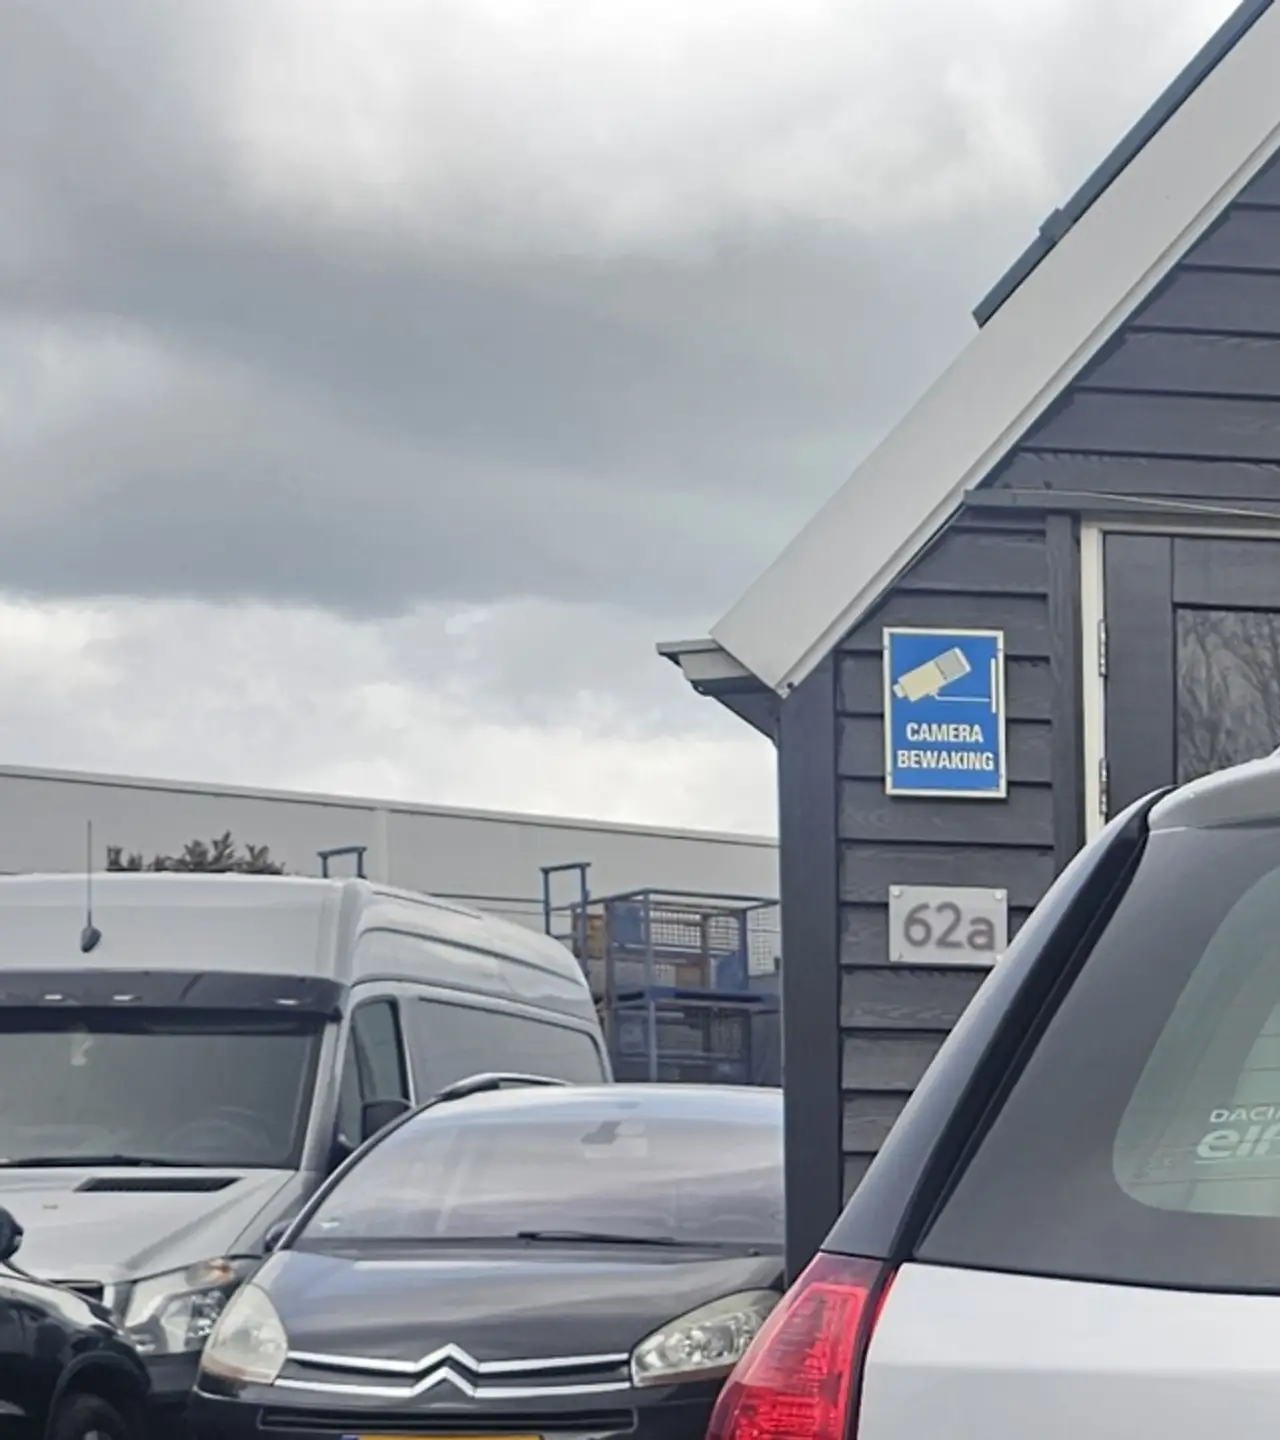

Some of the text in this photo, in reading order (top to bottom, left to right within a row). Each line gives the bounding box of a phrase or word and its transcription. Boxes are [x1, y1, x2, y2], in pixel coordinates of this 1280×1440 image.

[906, 722, 984, 744] CAMERA
[897, 750, 994, 771] BEWAKING
[903, 902, 996, 951] 62a
